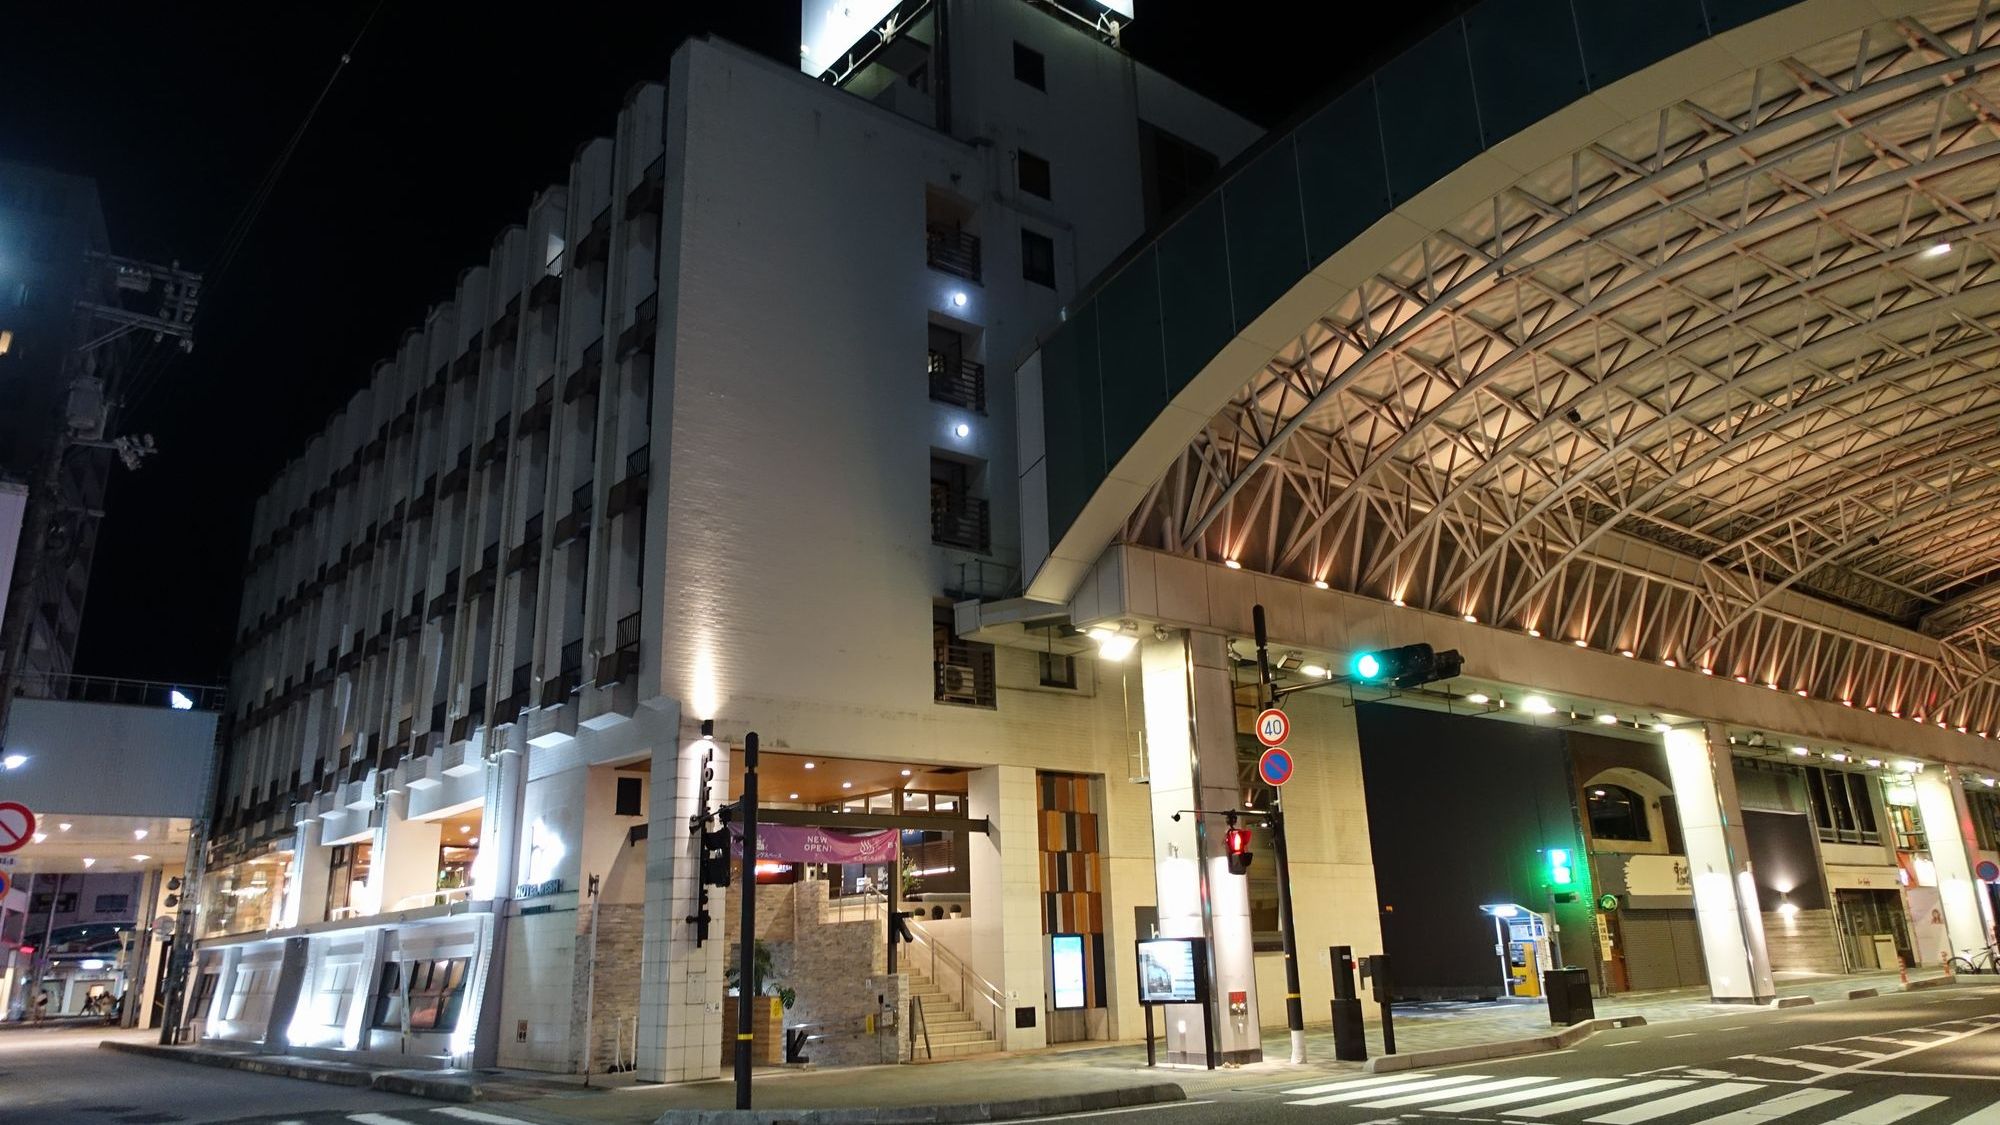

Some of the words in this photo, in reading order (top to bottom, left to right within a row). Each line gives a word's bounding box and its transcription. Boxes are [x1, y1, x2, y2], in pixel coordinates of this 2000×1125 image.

[1264, 719, 1282, 736] 40
[807, 835, 828, 844] NEW
[804, 843, 832, 853] OPEN!
